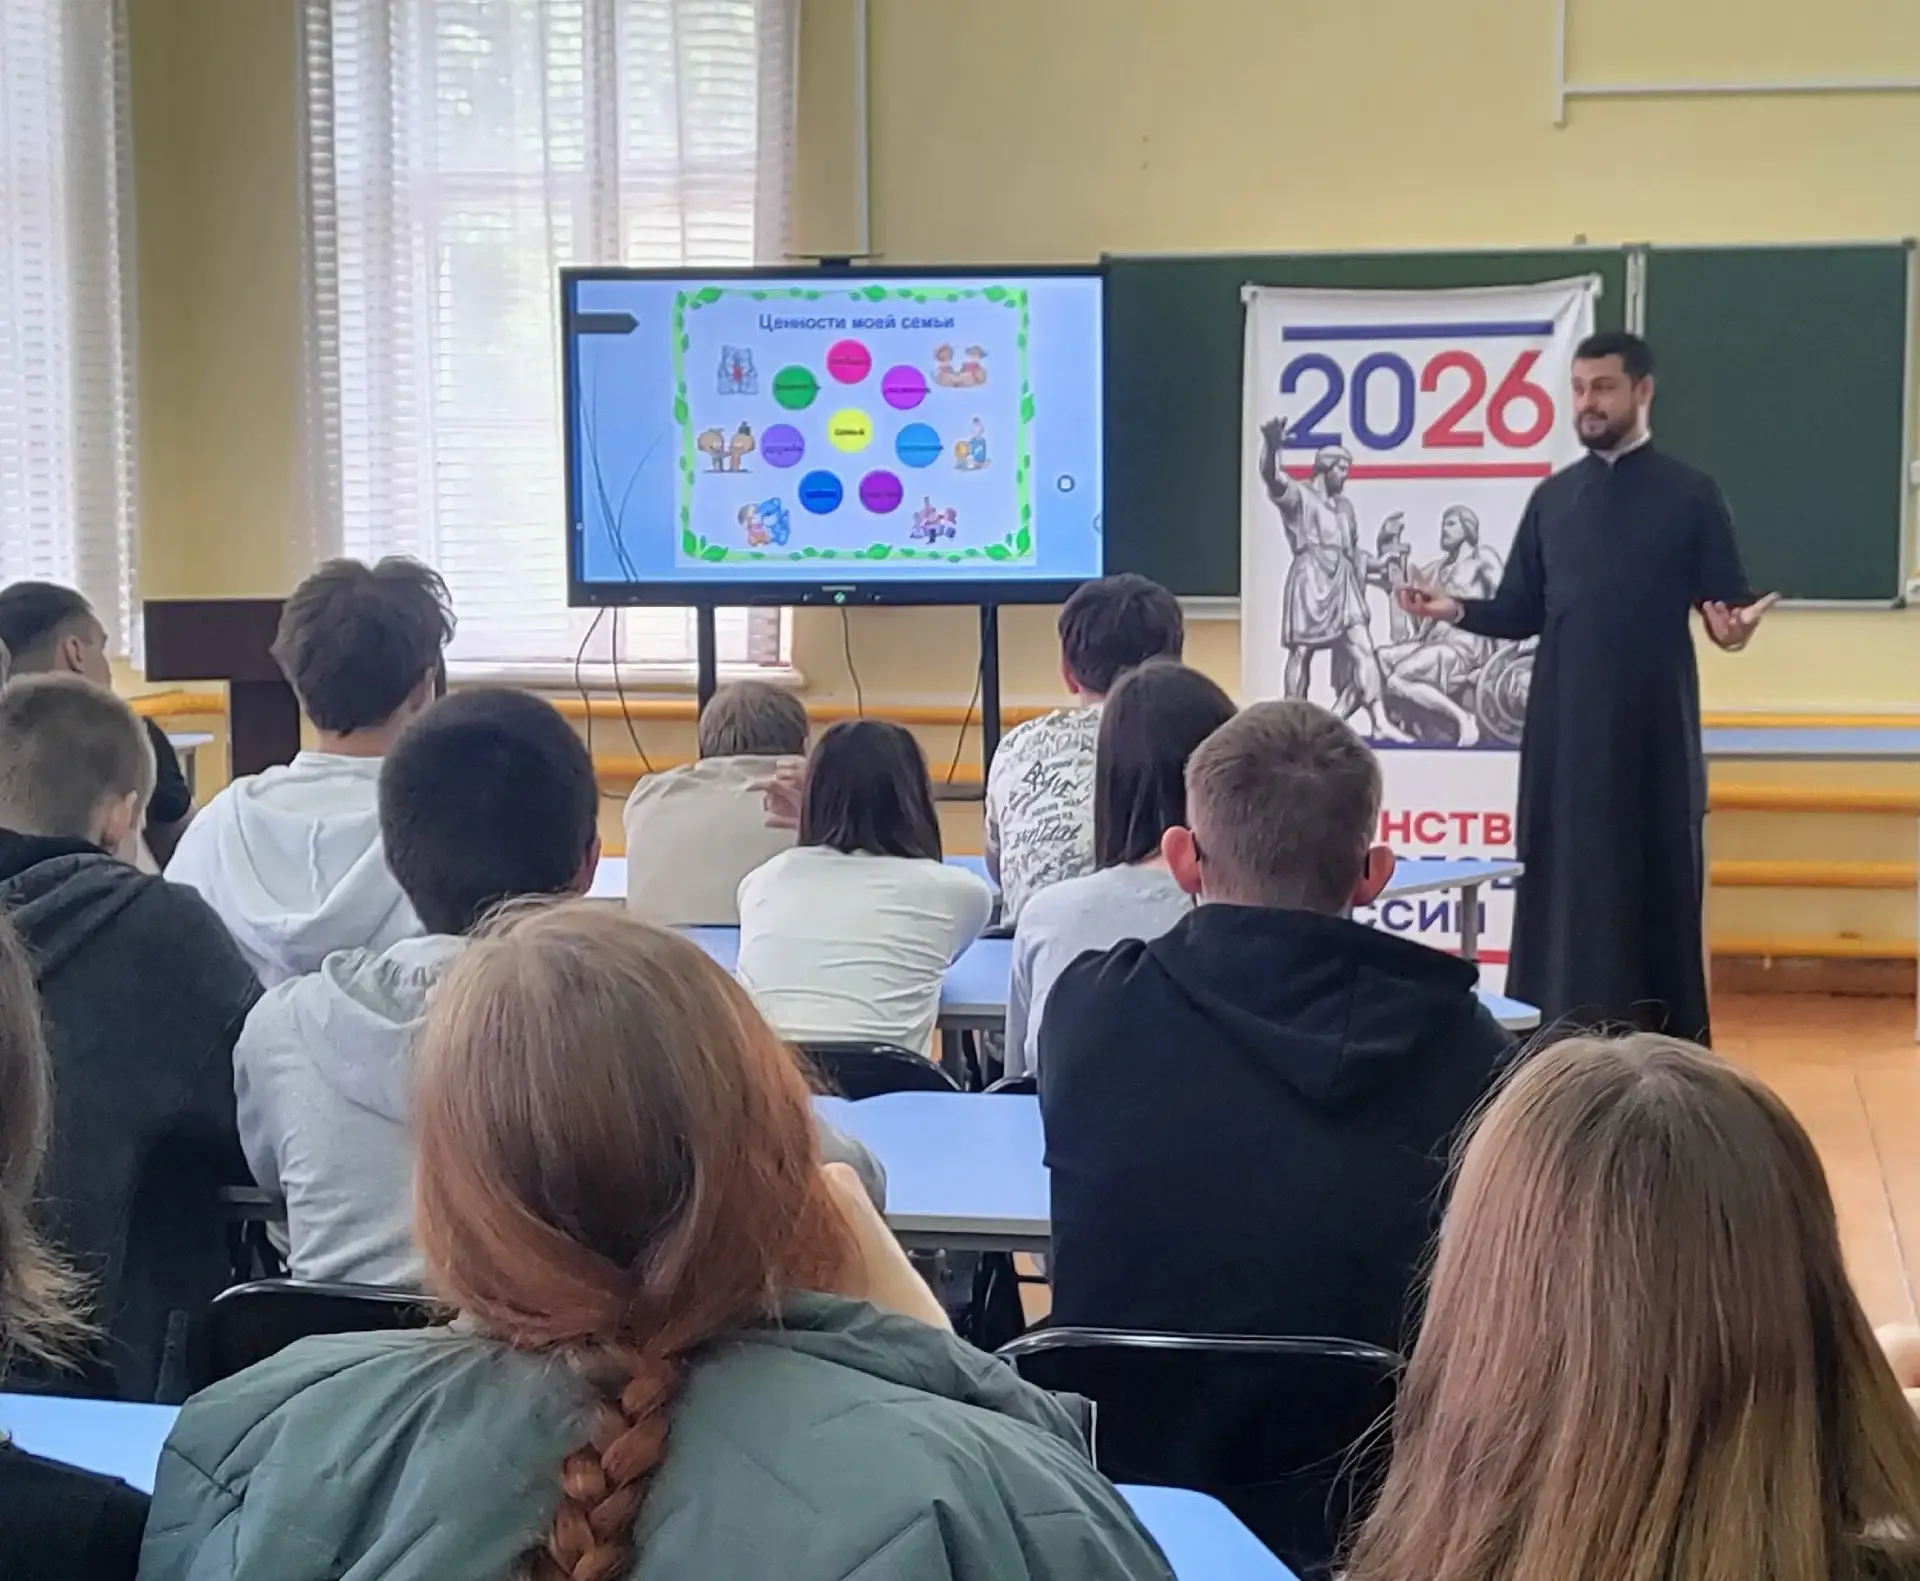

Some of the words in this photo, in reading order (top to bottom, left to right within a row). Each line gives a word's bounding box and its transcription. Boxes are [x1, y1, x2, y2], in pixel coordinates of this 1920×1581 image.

[759, 313, 846, 332] Ценности
[852, 314, 896, 329] моей
[901, 316, 955, 329] семьи
[1280, 350, 1555, 450] 2026
[1381, 810, 1512, 845] НСТВ
